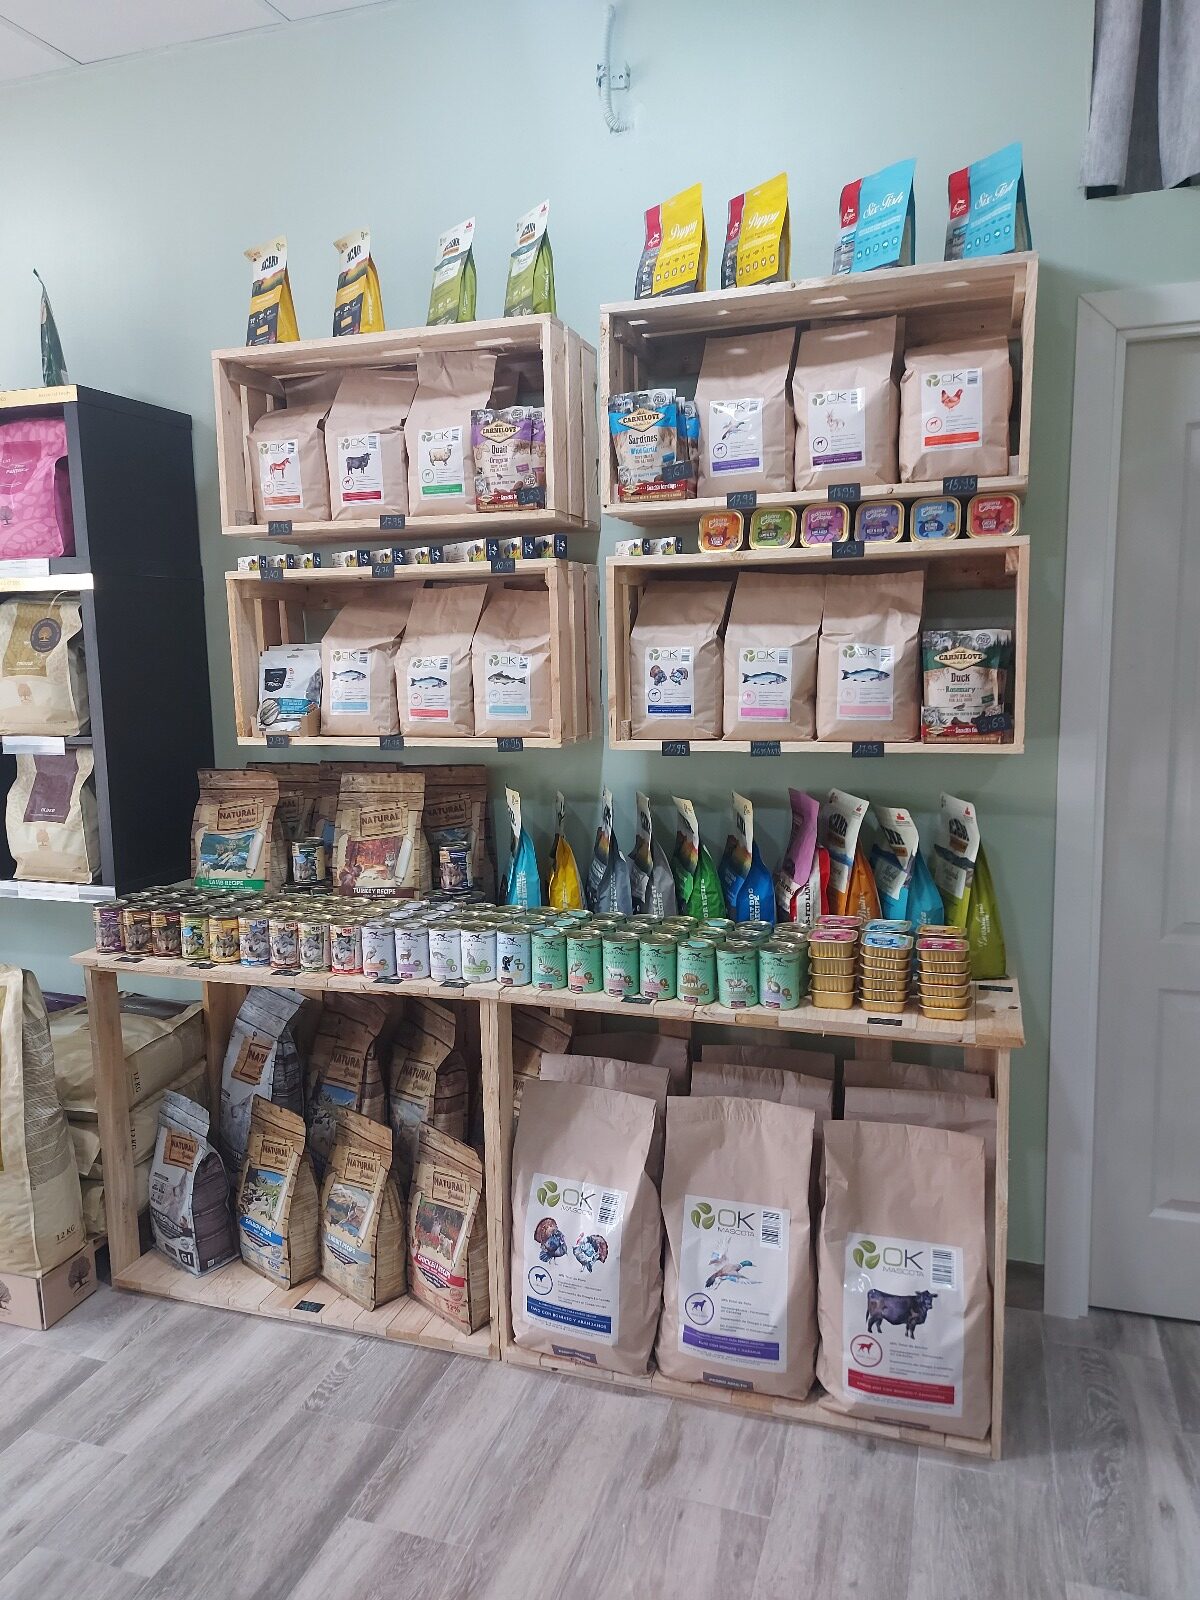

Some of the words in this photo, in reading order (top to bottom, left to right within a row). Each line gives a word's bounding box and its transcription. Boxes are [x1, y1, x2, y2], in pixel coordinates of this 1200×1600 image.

[746, 210, 781, 230] Puppy
[669, 219, 698, 241] Puppy
[628, 434, 658, 445] Sardines
[491, 445, 508, 454] Quail
[939, 653, 983, 661] CARNILOVE
[951, 672, 970, 682] Duck
[220, 809, 256, 820] NATURAL
[428, 804, 464, 816] NATURAL
[362, 812, 400, 825] NATURAL
[250, 1049, 267, 1064] NATU
[330, 1053, 360, 1070] NATURA
[402, 1065, 432, 1083] NATURAL
[171, 1139, 194, 1152] NATURAL
[262, 1144, 288, 1158] NATURAL
[346, 1157, 375, 1173] NATURAL
[433, 1177, 464, 1194] NATURAL
[562, 1188, 597, 1211] OK
[717, 1208, 756, 1231] OK
[56, 1230, 66, 1241] 12
[66, 1223, 75, 1235] KG
[717, 1226, 755, 1237] MASCOTA
[180, 1254, 192, 1266] GI
[417, 1254, 438, 1271] CHICKEN
[883, 1247, 924, 1270] OK
[882, 1266, 925, 1277] MASCOTA
